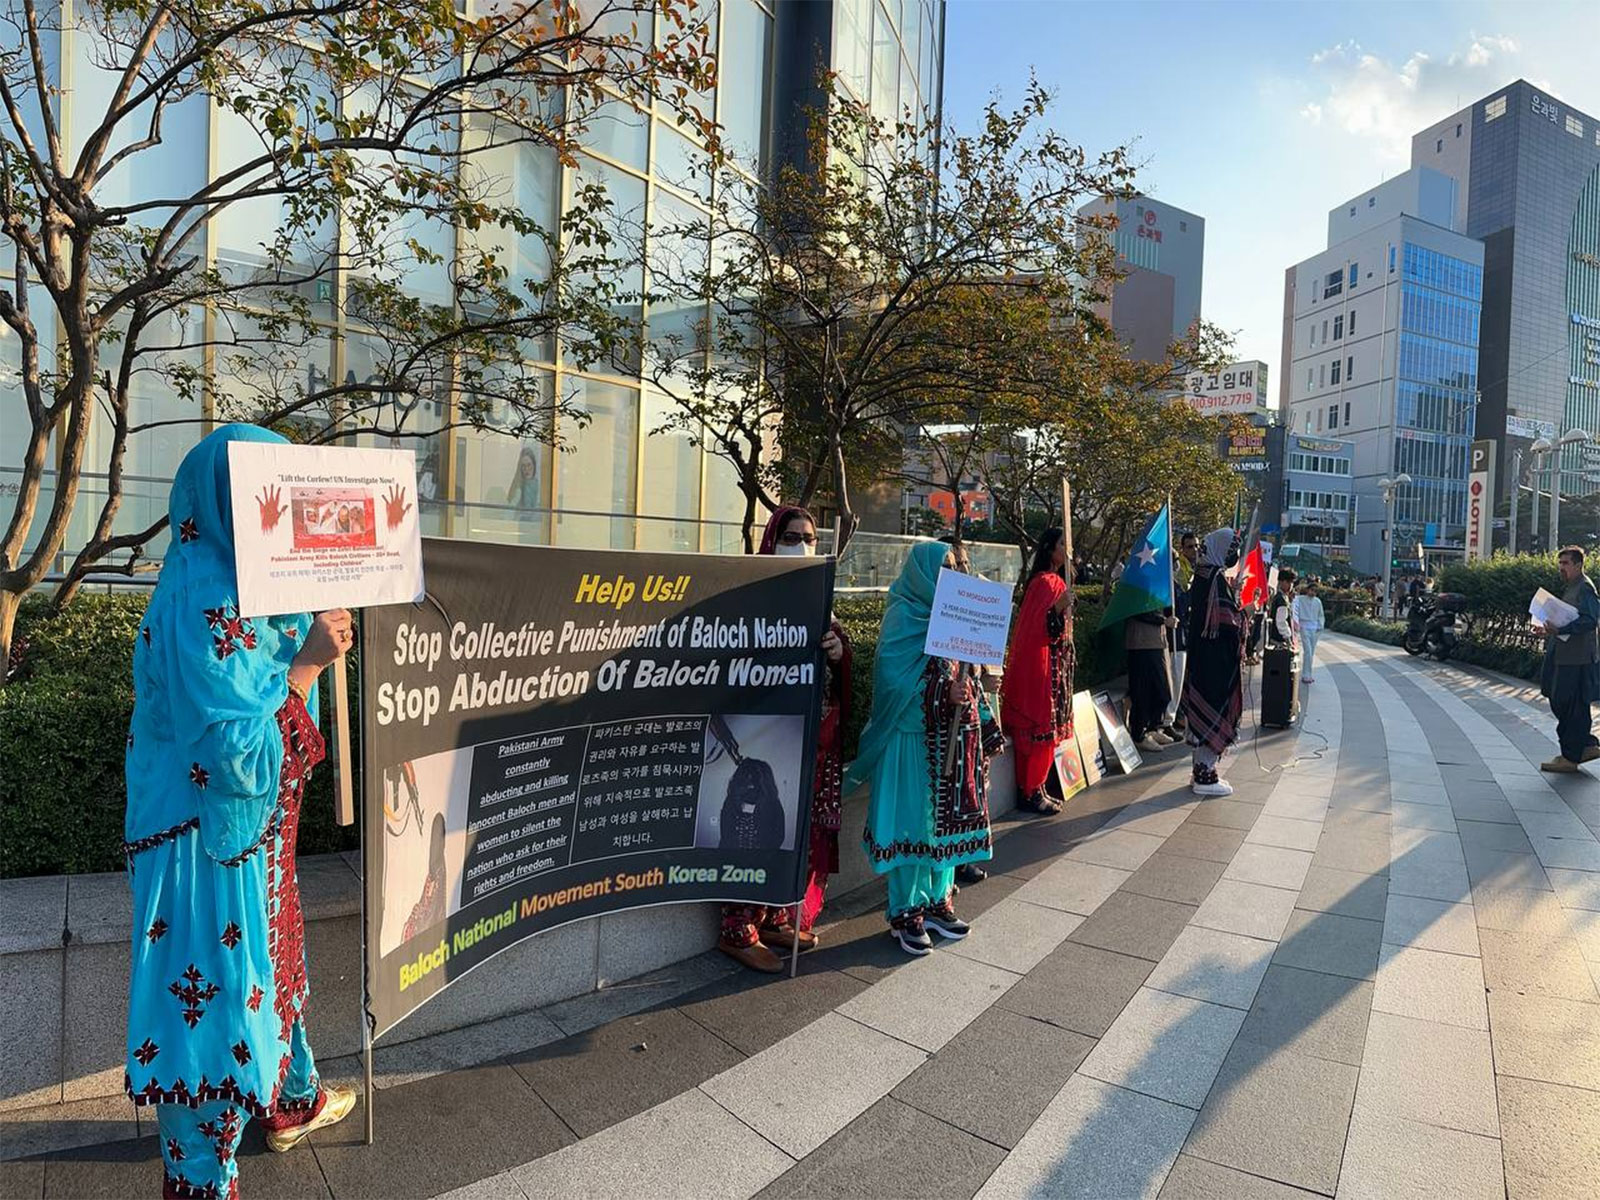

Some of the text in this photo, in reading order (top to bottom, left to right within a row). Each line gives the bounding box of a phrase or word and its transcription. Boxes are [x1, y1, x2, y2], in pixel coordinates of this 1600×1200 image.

[1531, 95, 1559, 124] 은과빛
[1191, 370, 1253, 393] 광고임대
[1473, 450, 1484, 469] P
[295, 474, 305, 483] the
[345, 476, 378, 485] Investigate
[1470, 498, 1480, 547] LOTTE
[575, 574, 691, 610] Help Us!!
[394, 616, 808, 671] Stop Collective Punishment of Baloch Nation
[377, 657, 814, 727] Stop Abduction Of Baloch Women
[595, 724, 632, 739] 파키스탄
[634, 722, 662, 734] 군대는
[498, 735, 565, 757] Pakistani Army
[589, 741, 700, 763] 권리와 자유를 요구하는 발
[505, 757, 551, 776] constantly
[622, 765, 649, 778] 국가를
[652, 763, 702, 776] 침묵시키기
[480, 774, 569, 806] abducting and killing
[584, 794, 602, 808] 위해
[605, 787, 651, 804] 지속적으로
[468, 791, 576, 832] innocent Baloch men and
[579, 806, 693, 833] 남성과 여성을 살해하고 납
[477, 816, 562, 852] women to silent the
[613, 832, 653, 847] 치합니다.
[467, 834, 568, 879] nation who ask for their
[474, 857, 555, 897] rights and freedom.
[400, 864, 766, 992] Baloch National Movement South Korea Zone
